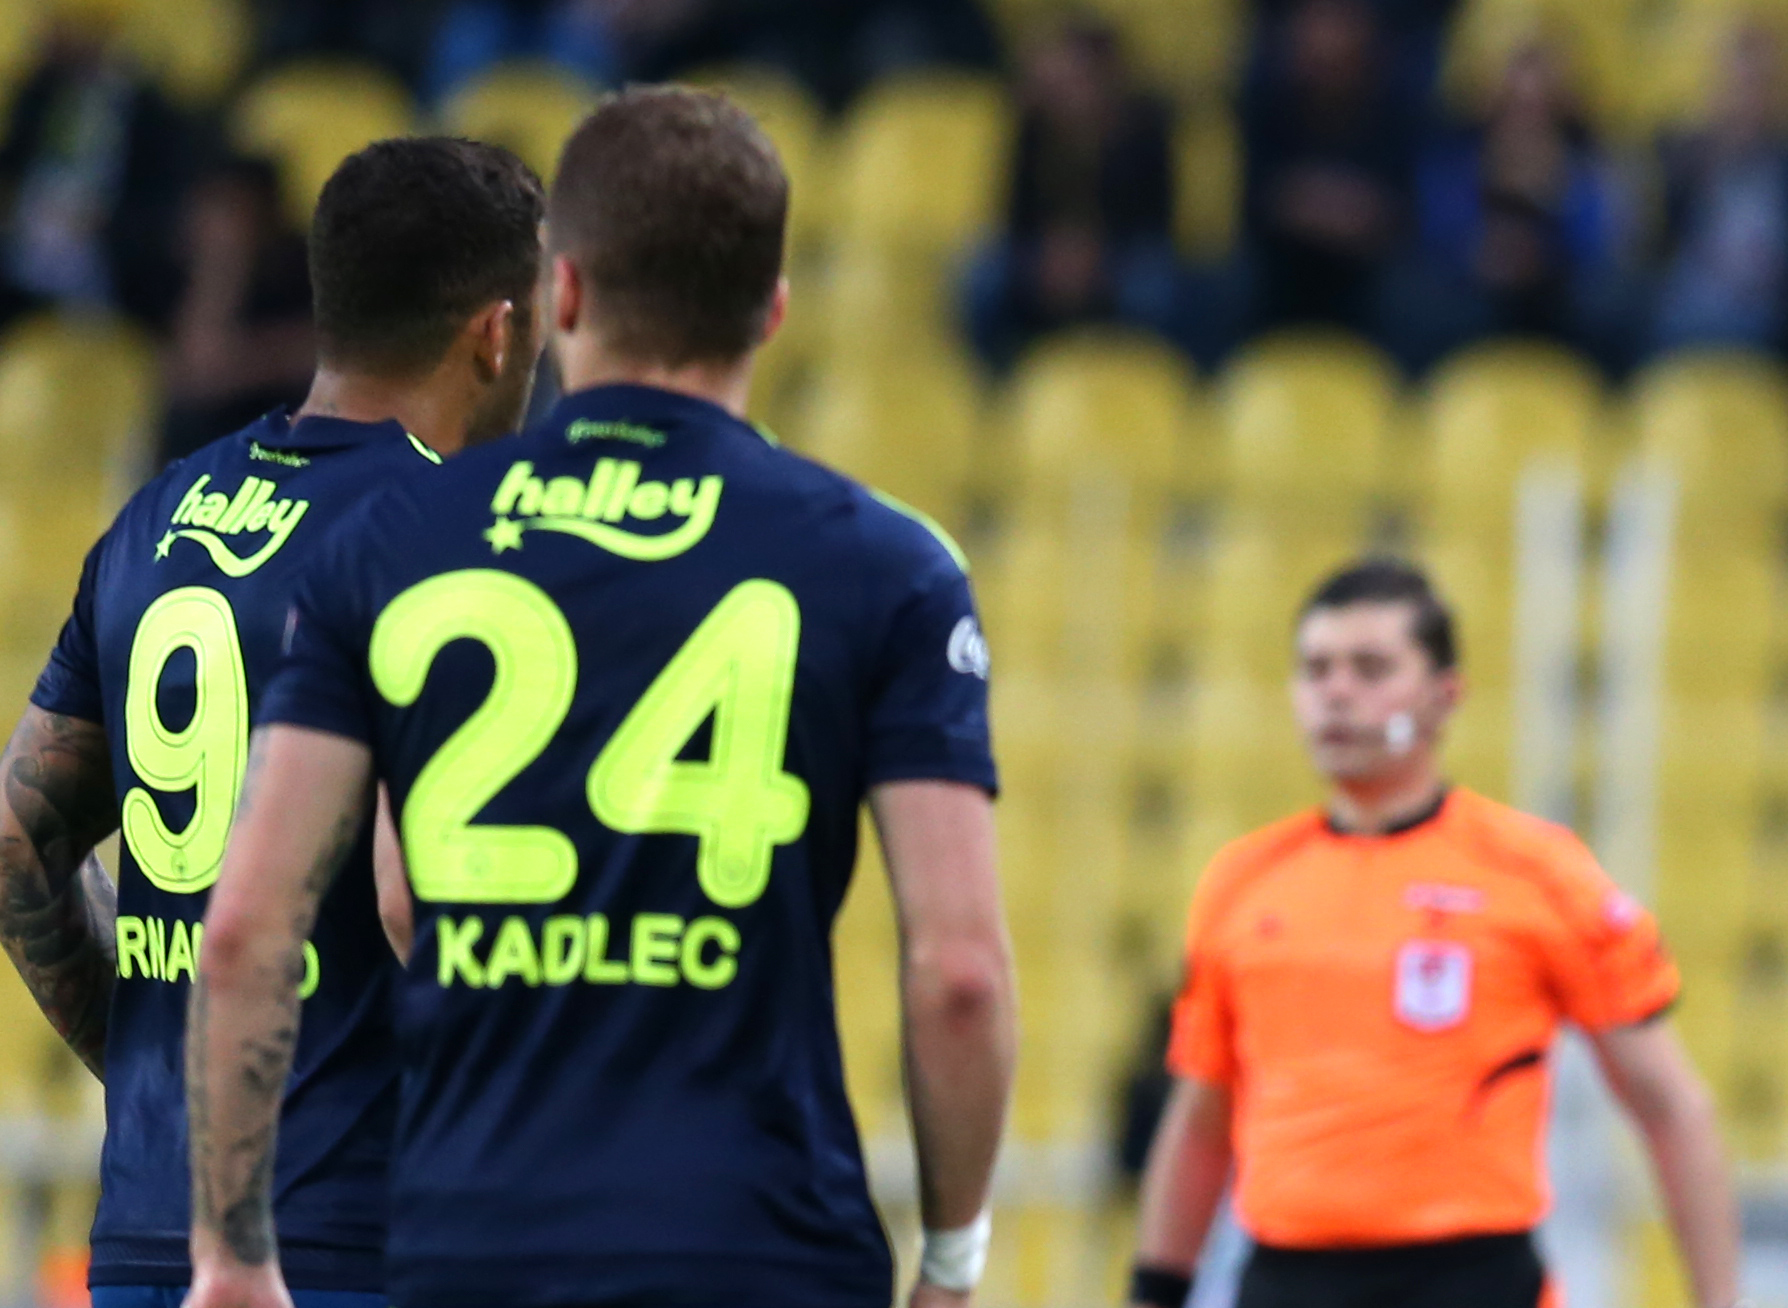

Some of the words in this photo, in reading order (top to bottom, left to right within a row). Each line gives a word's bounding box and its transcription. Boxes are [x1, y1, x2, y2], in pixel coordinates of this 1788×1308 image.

[170, 473, 310, 578] halley
[490, 458, 726, 562] halley
[122, 586, 250, 894] 9
[367, 568, 811, 908] 24
[436, 911, 742, 990] KADLEC
